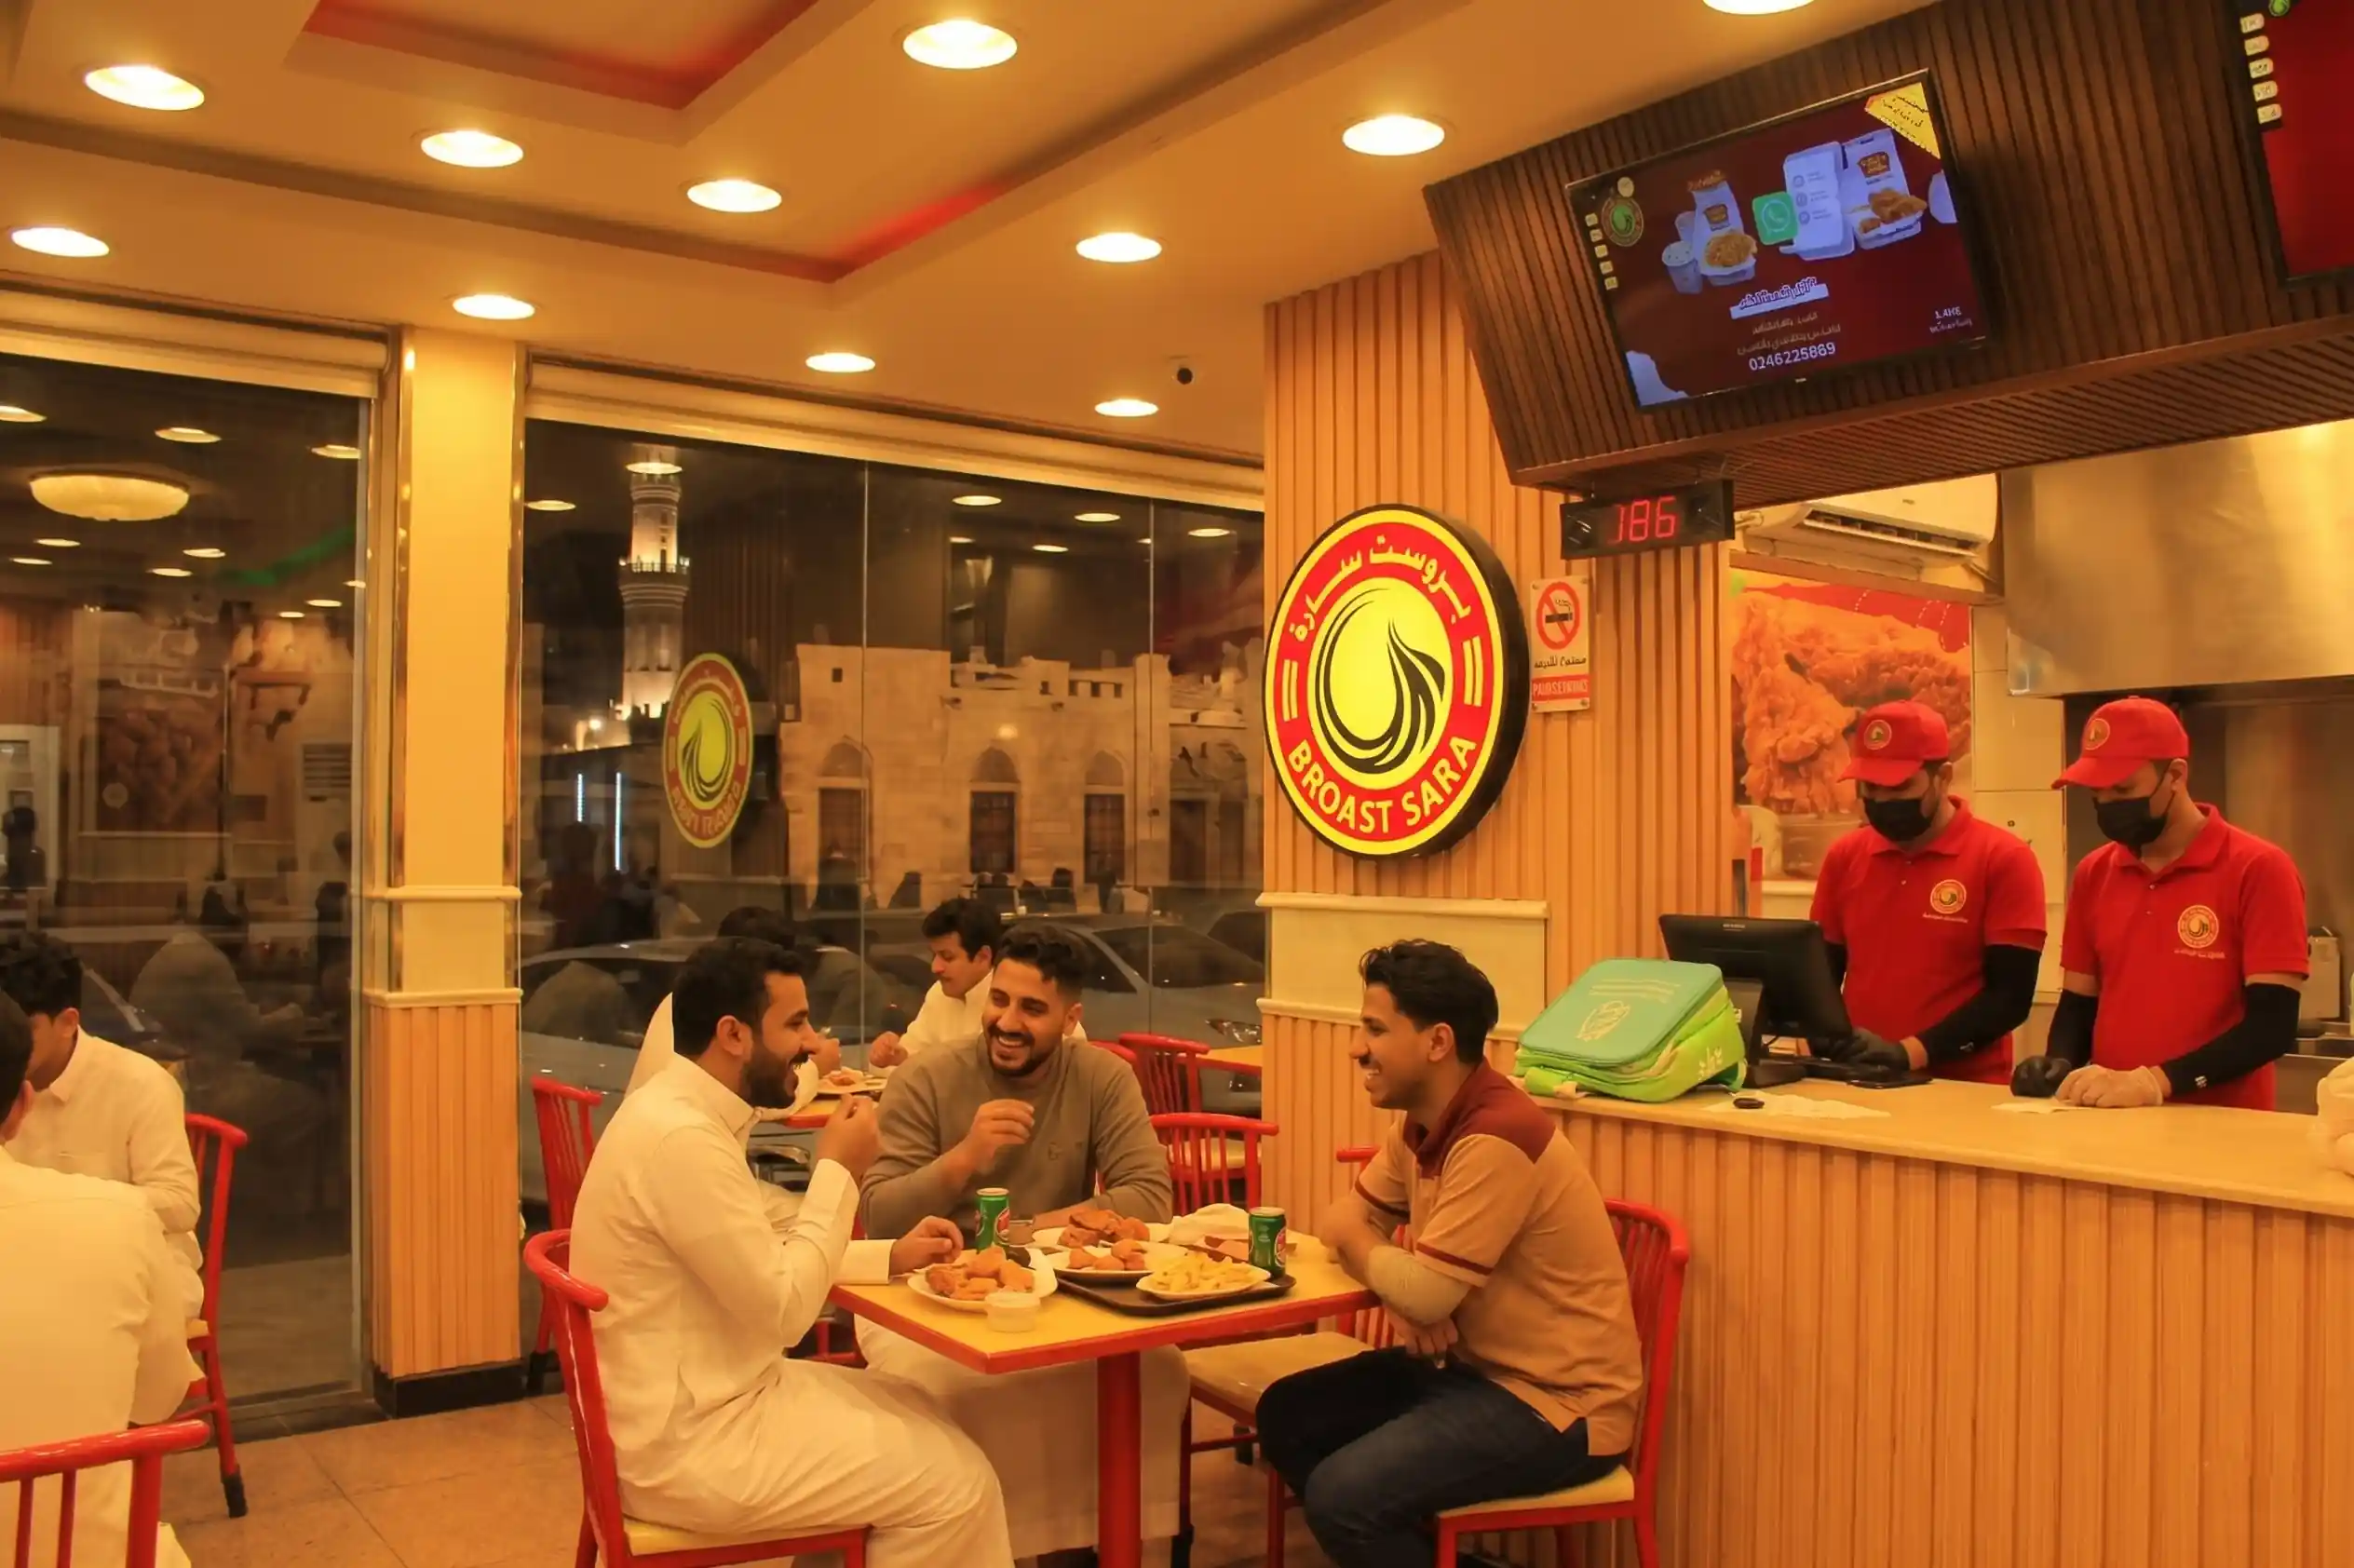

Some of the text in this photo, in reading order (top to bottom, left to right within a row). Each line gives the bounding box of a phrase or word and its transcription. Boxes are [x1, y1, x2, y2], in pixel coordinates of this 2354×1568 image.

[1615, 495, 1676, 545] 186
[1369, 534, 1472, 625] بروست
[1288, 736, 1477, 833] BROAST SARA
